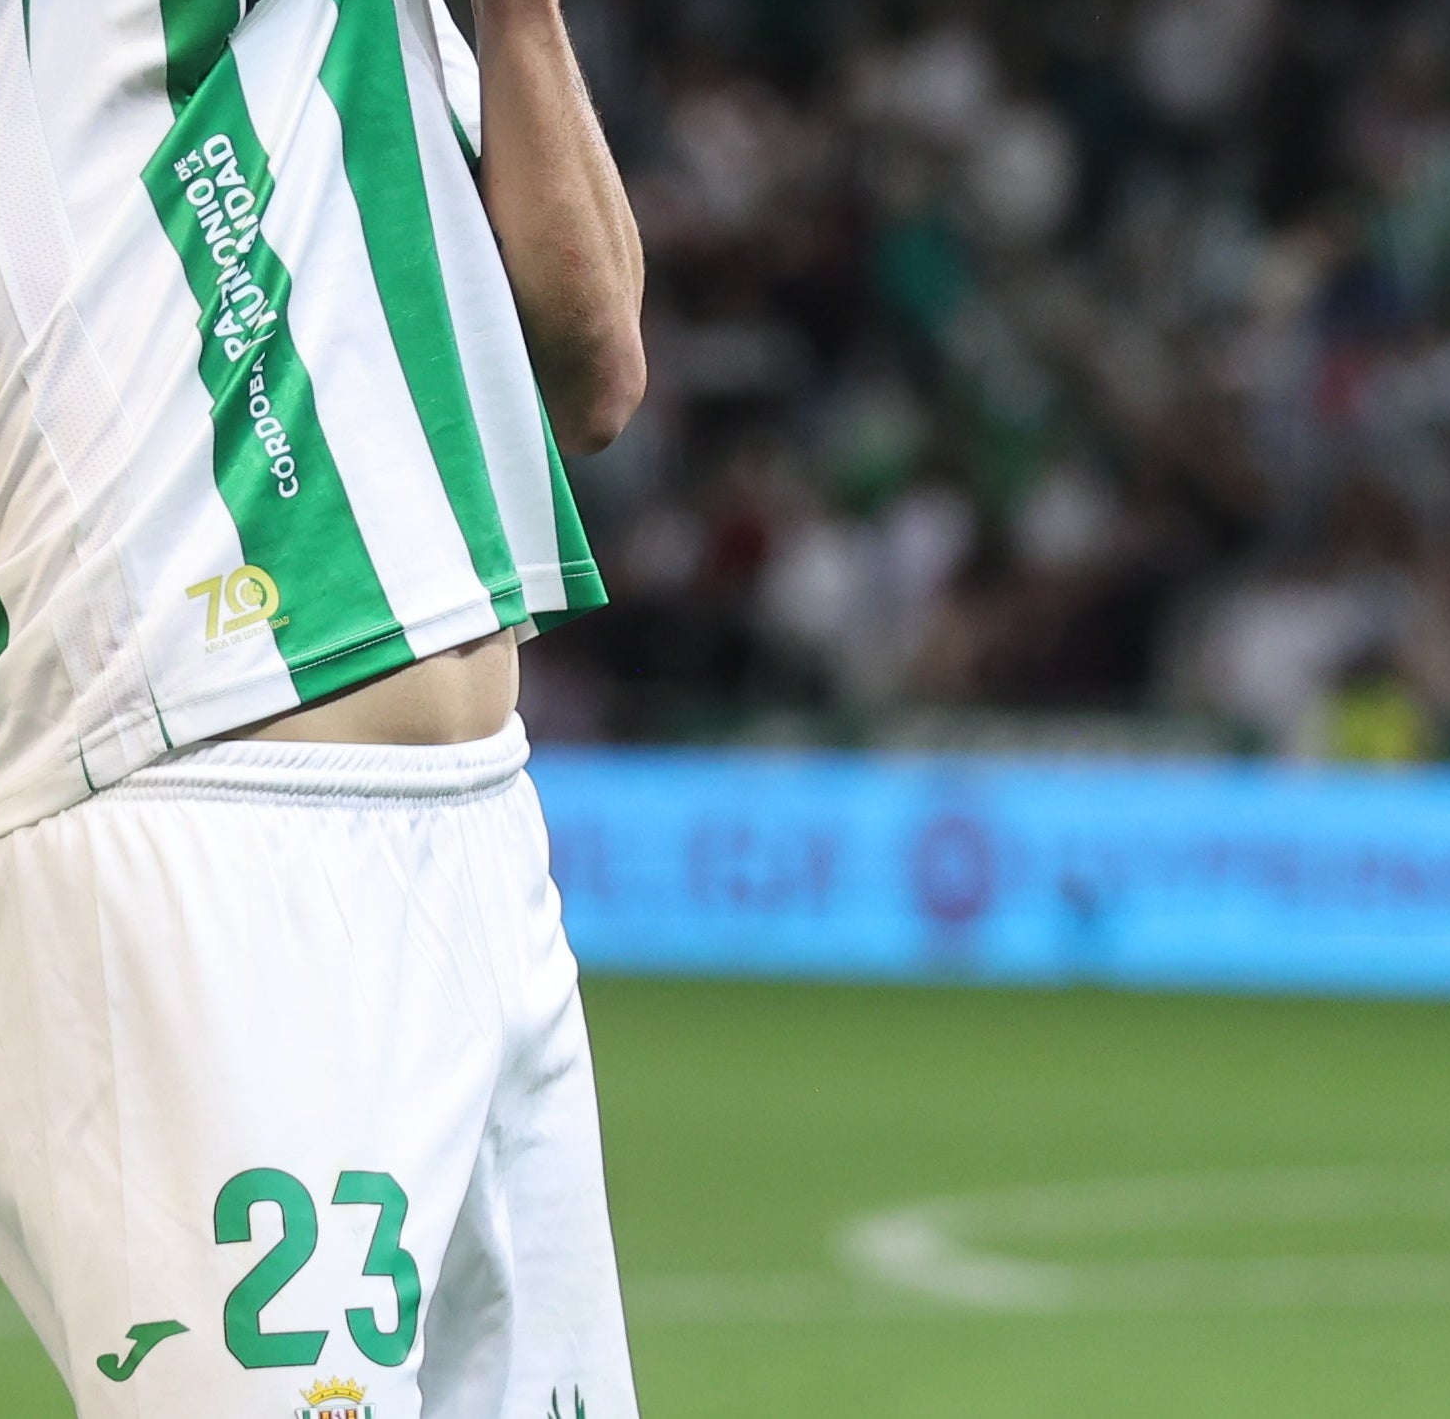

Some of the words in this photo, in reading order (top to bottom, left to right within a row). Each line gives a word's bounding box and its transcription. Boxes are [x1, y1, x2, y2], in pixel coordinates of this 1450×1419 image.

[173, 157, 193, 182] DE
[186, 149, 205, 173] LA
[249, 351, 300, 499] CÓRDOBA
[185, 564, 280, 641] 70
[214, 1167, 421, 1369] 23
